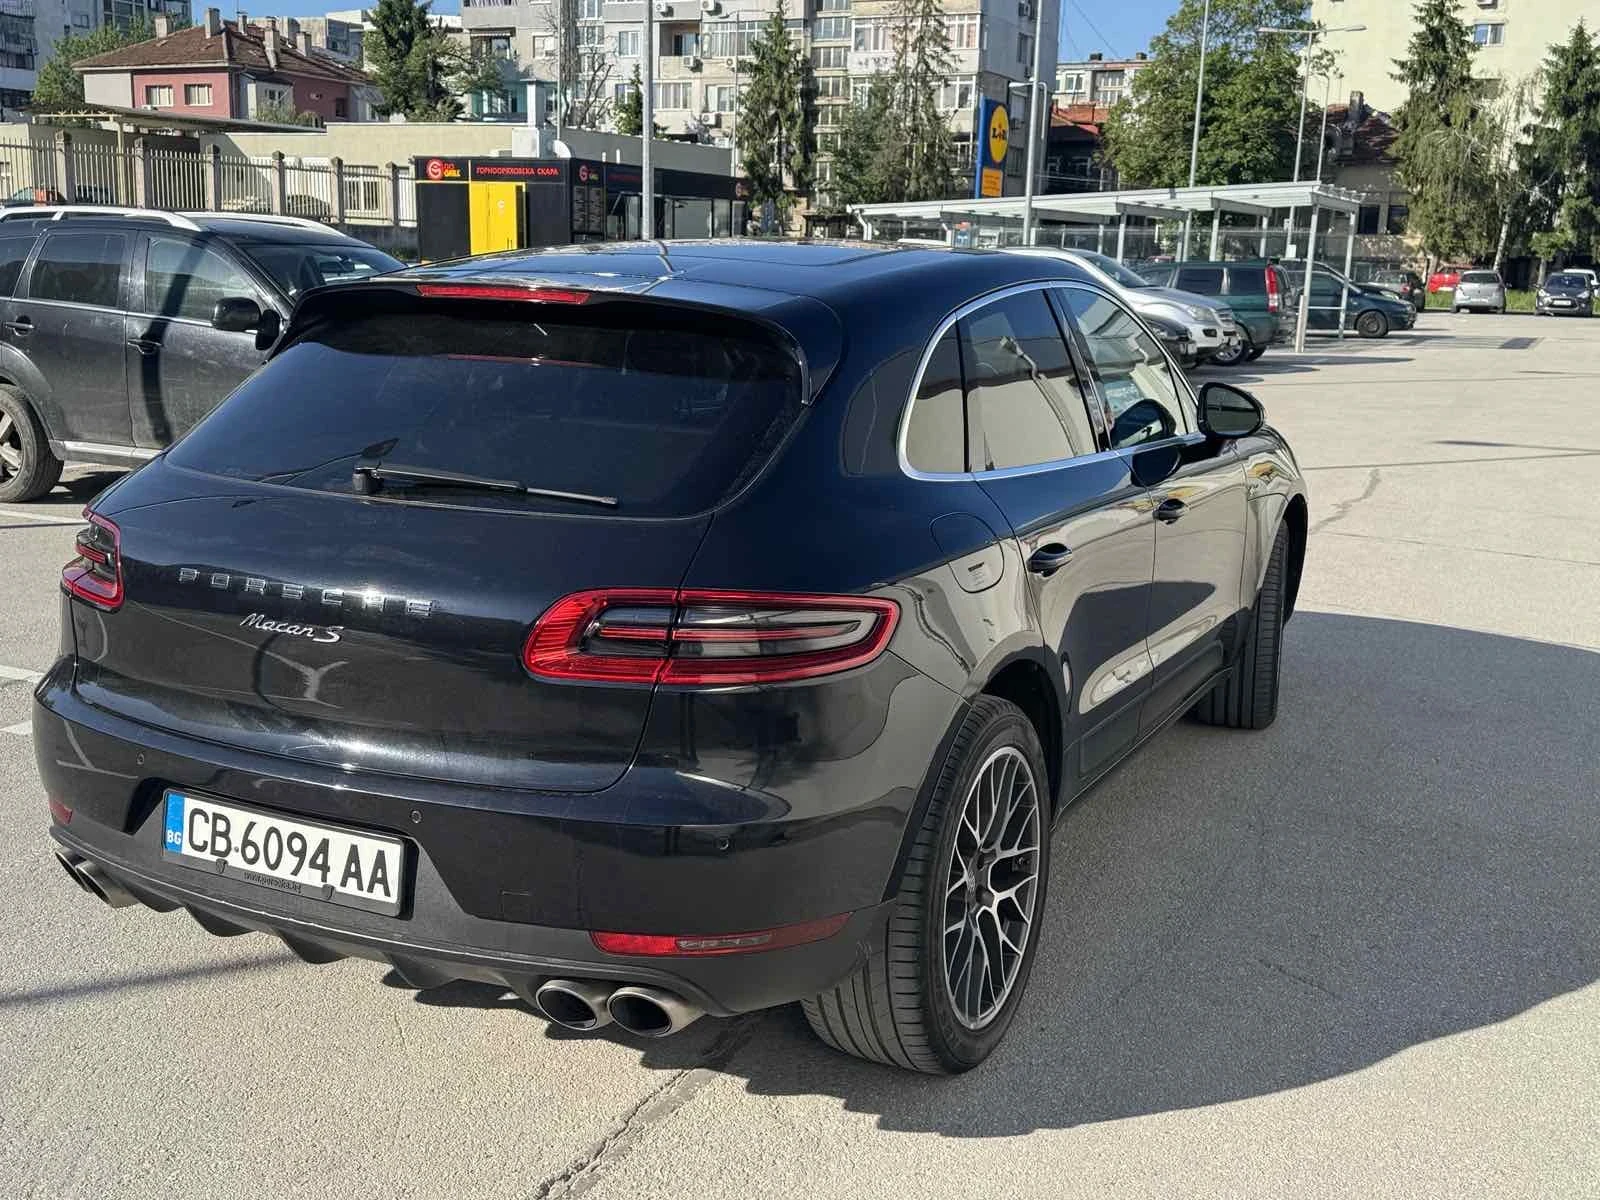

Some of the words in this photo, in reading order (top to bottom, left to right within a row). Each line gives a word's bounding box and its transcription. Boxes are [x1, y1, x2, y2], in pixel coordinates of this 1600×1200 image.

[178, 567, 434, 617] PORSCHE
[239, 612, 314, 638] Macan
[312, 625, 344, 643] S
[165, 829, 183, 845] BG
[240, 821, 331, 883] 6094
[339, 843, 391, 898] AA
